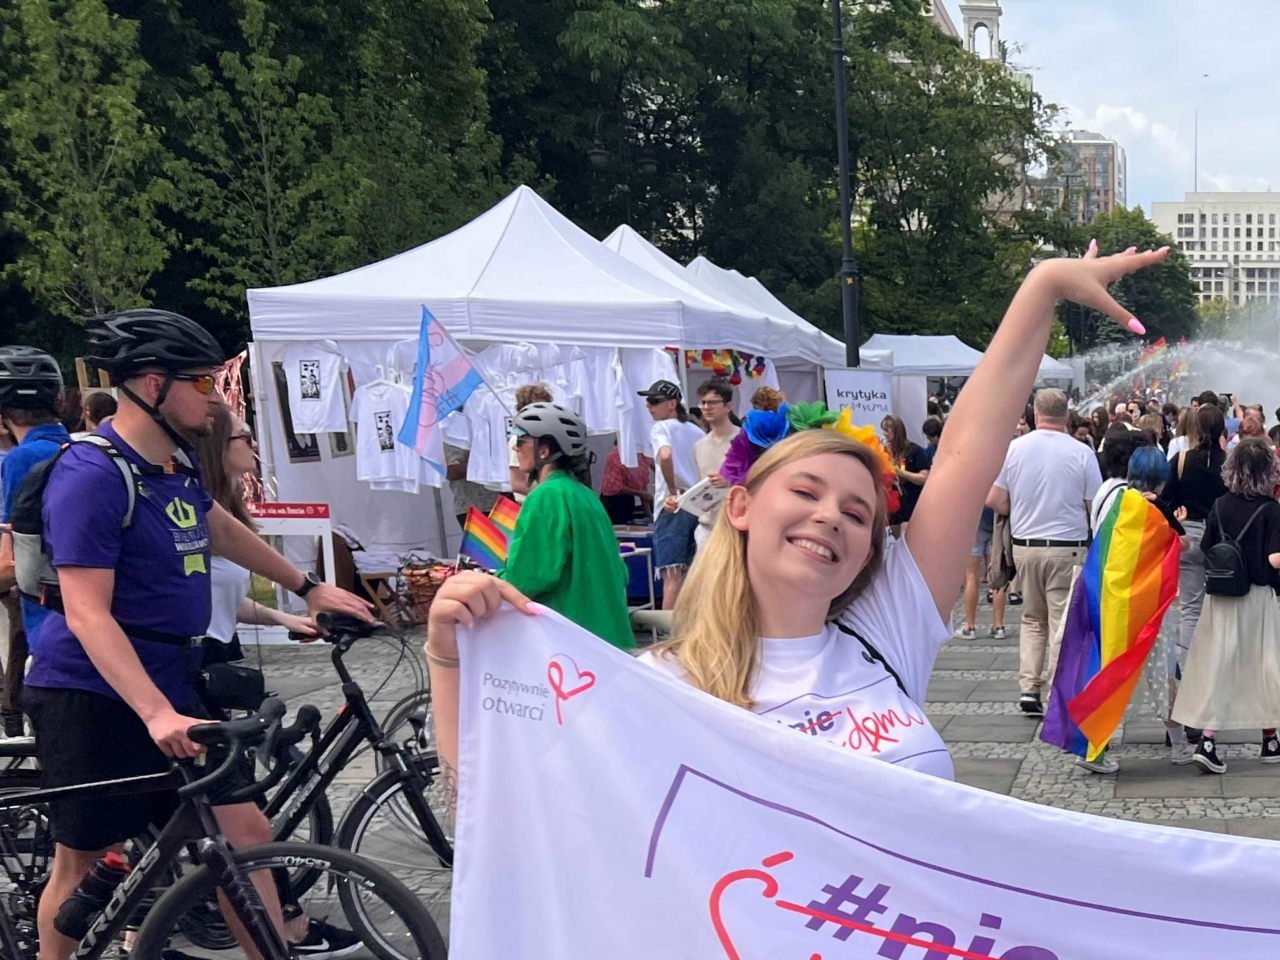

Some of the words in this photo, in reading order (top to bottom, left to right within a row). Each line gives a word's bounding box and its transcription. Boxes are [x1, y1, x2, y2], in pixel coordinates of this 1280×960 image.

[837, 388, 887, 401] krytyka
[483, 672, 549, 698] Pozytywnie
[482, 697, 545, 721] otwarci
